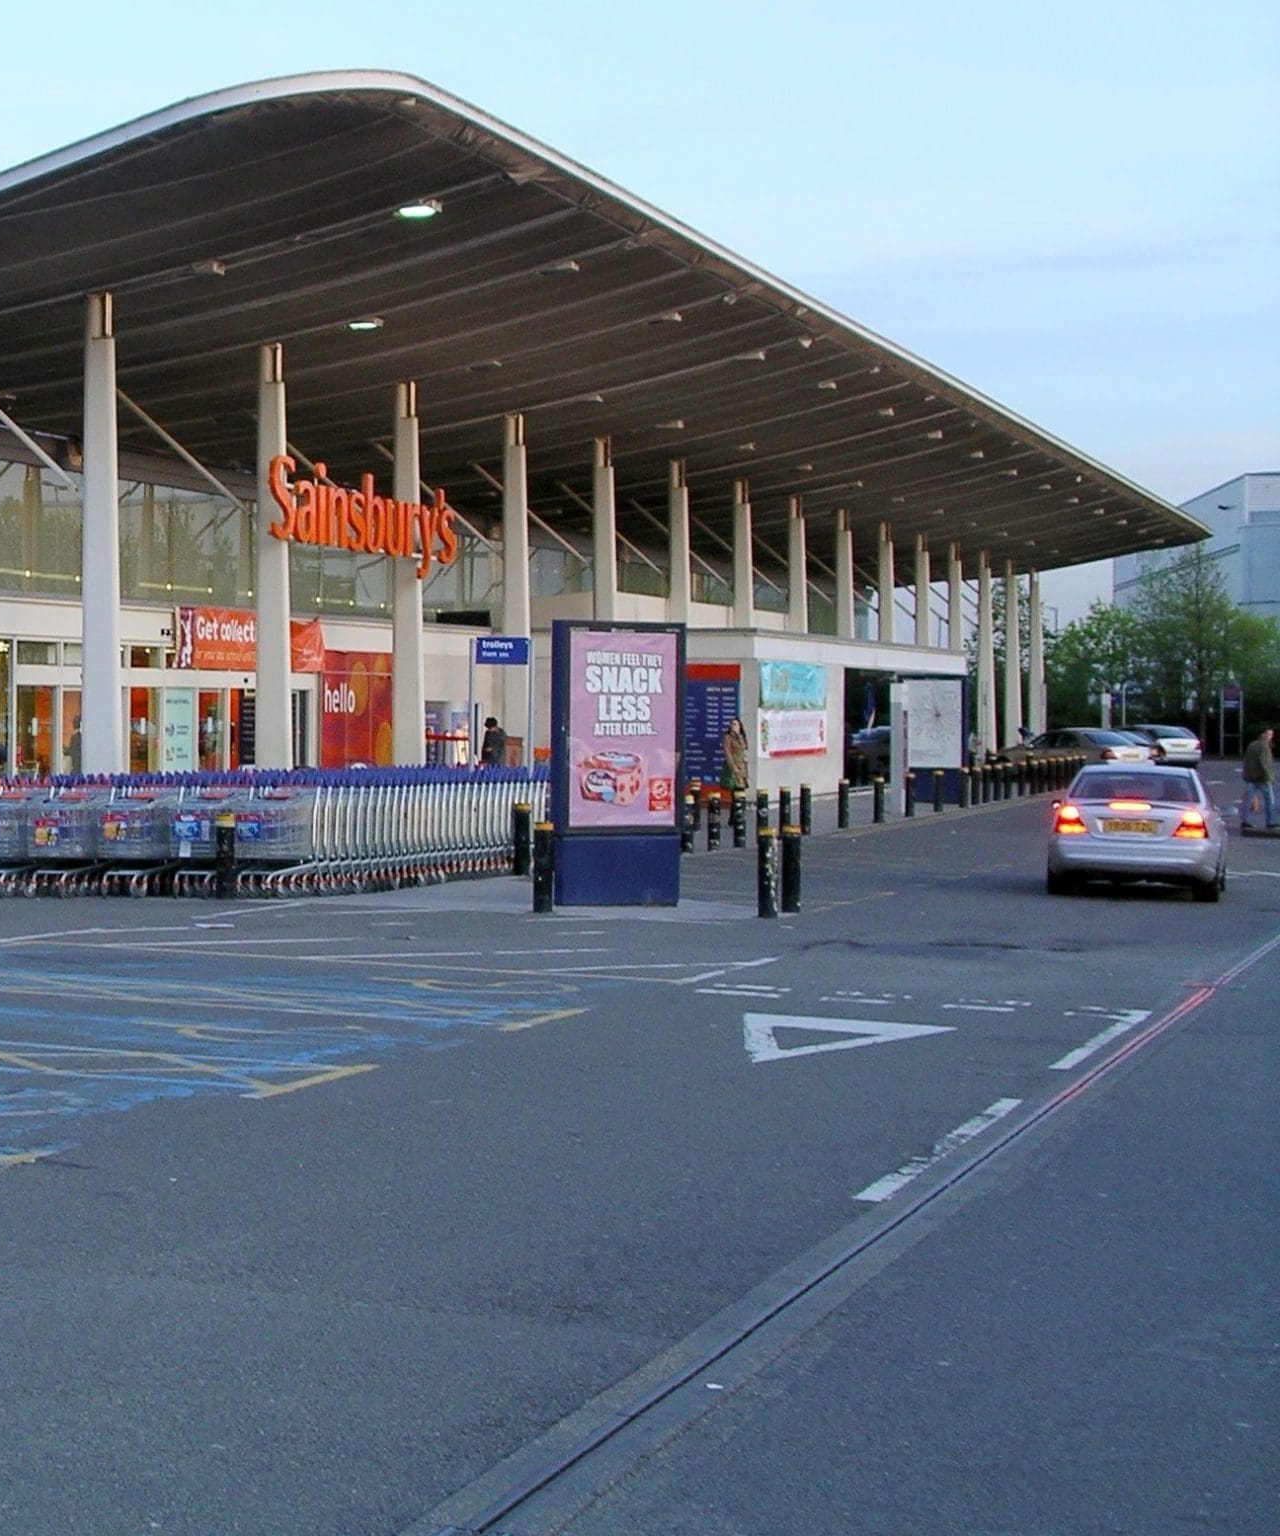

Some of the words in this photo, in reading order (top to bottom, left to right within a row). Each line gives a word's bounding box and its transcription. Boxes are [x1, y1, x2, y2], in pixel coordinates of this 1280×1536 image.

[268, 455, 458, 579] Sainsbury's
[196, 616, 218, 640] Get
[221, 618, 256, 643] collect
[482, 640, 514, 650] trolleys
[586, 650, 620, 666] WOMEN
[622, 653, 640, 666] FEEL
[642, 653, 663, 668] THEY
[585, 665, 663, 694] SNACK
[324, 682, 355, 713] hello
[598, 695, 651, 722] LESS
[593, 722, 621, 737] AFTER
